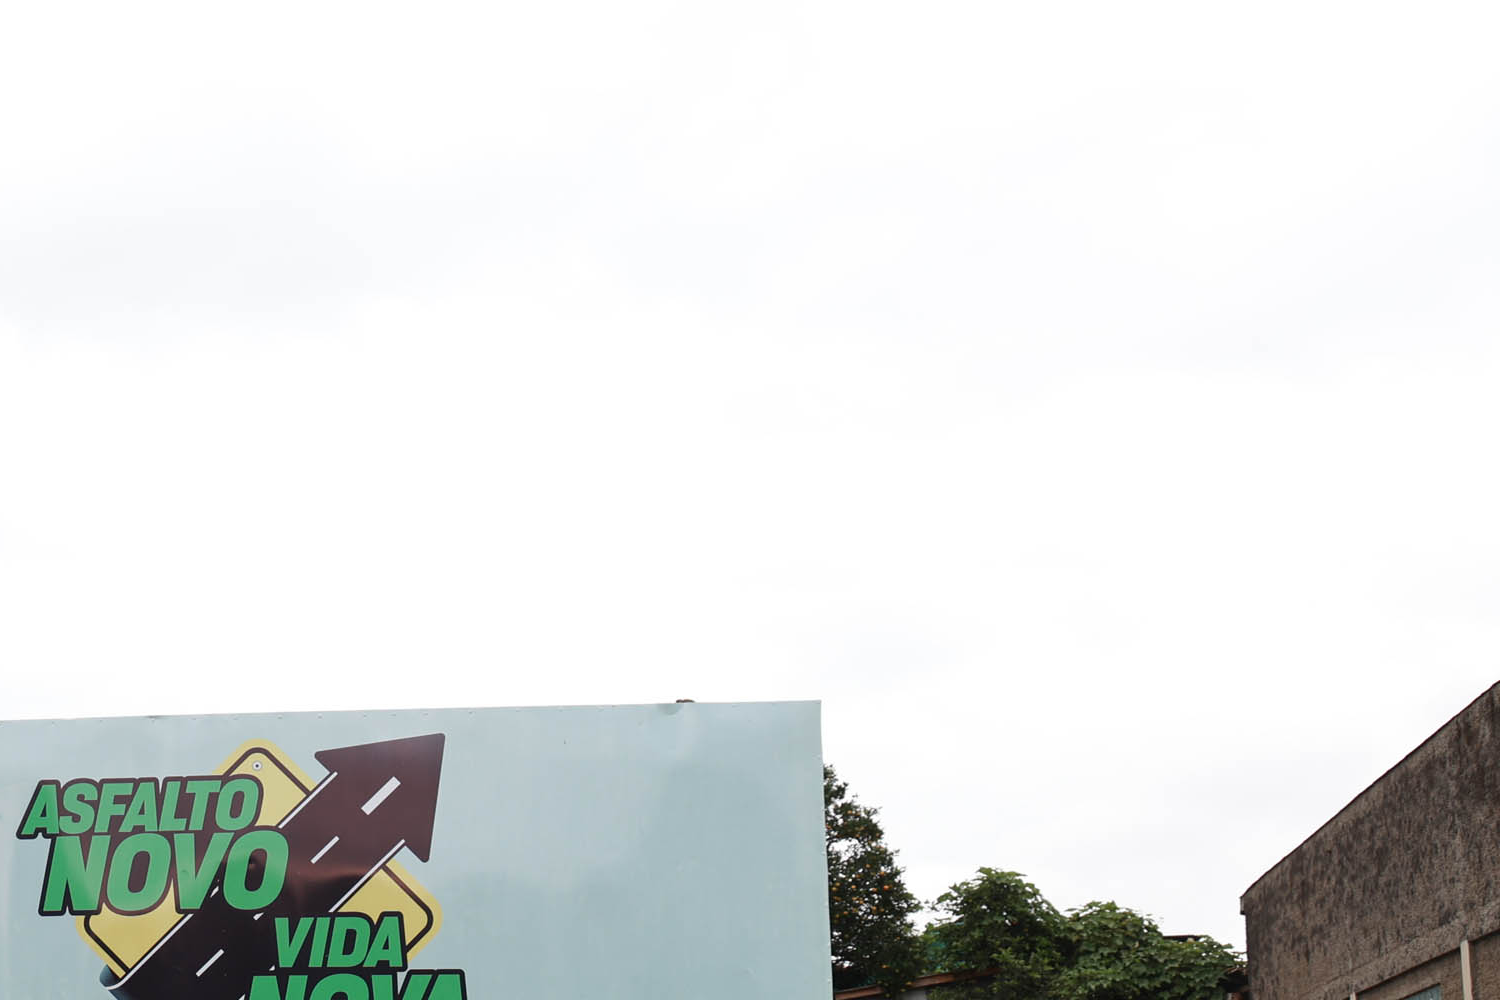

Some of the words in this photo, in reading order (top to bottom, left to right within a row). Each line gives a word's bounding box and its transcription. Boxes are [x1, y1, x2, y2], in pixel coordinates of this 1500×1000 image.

[17, 774, 263, 839] ASFALTO
[39, 825, 290, 915] NOVO
[270, 911, 407, 971] VIDA
